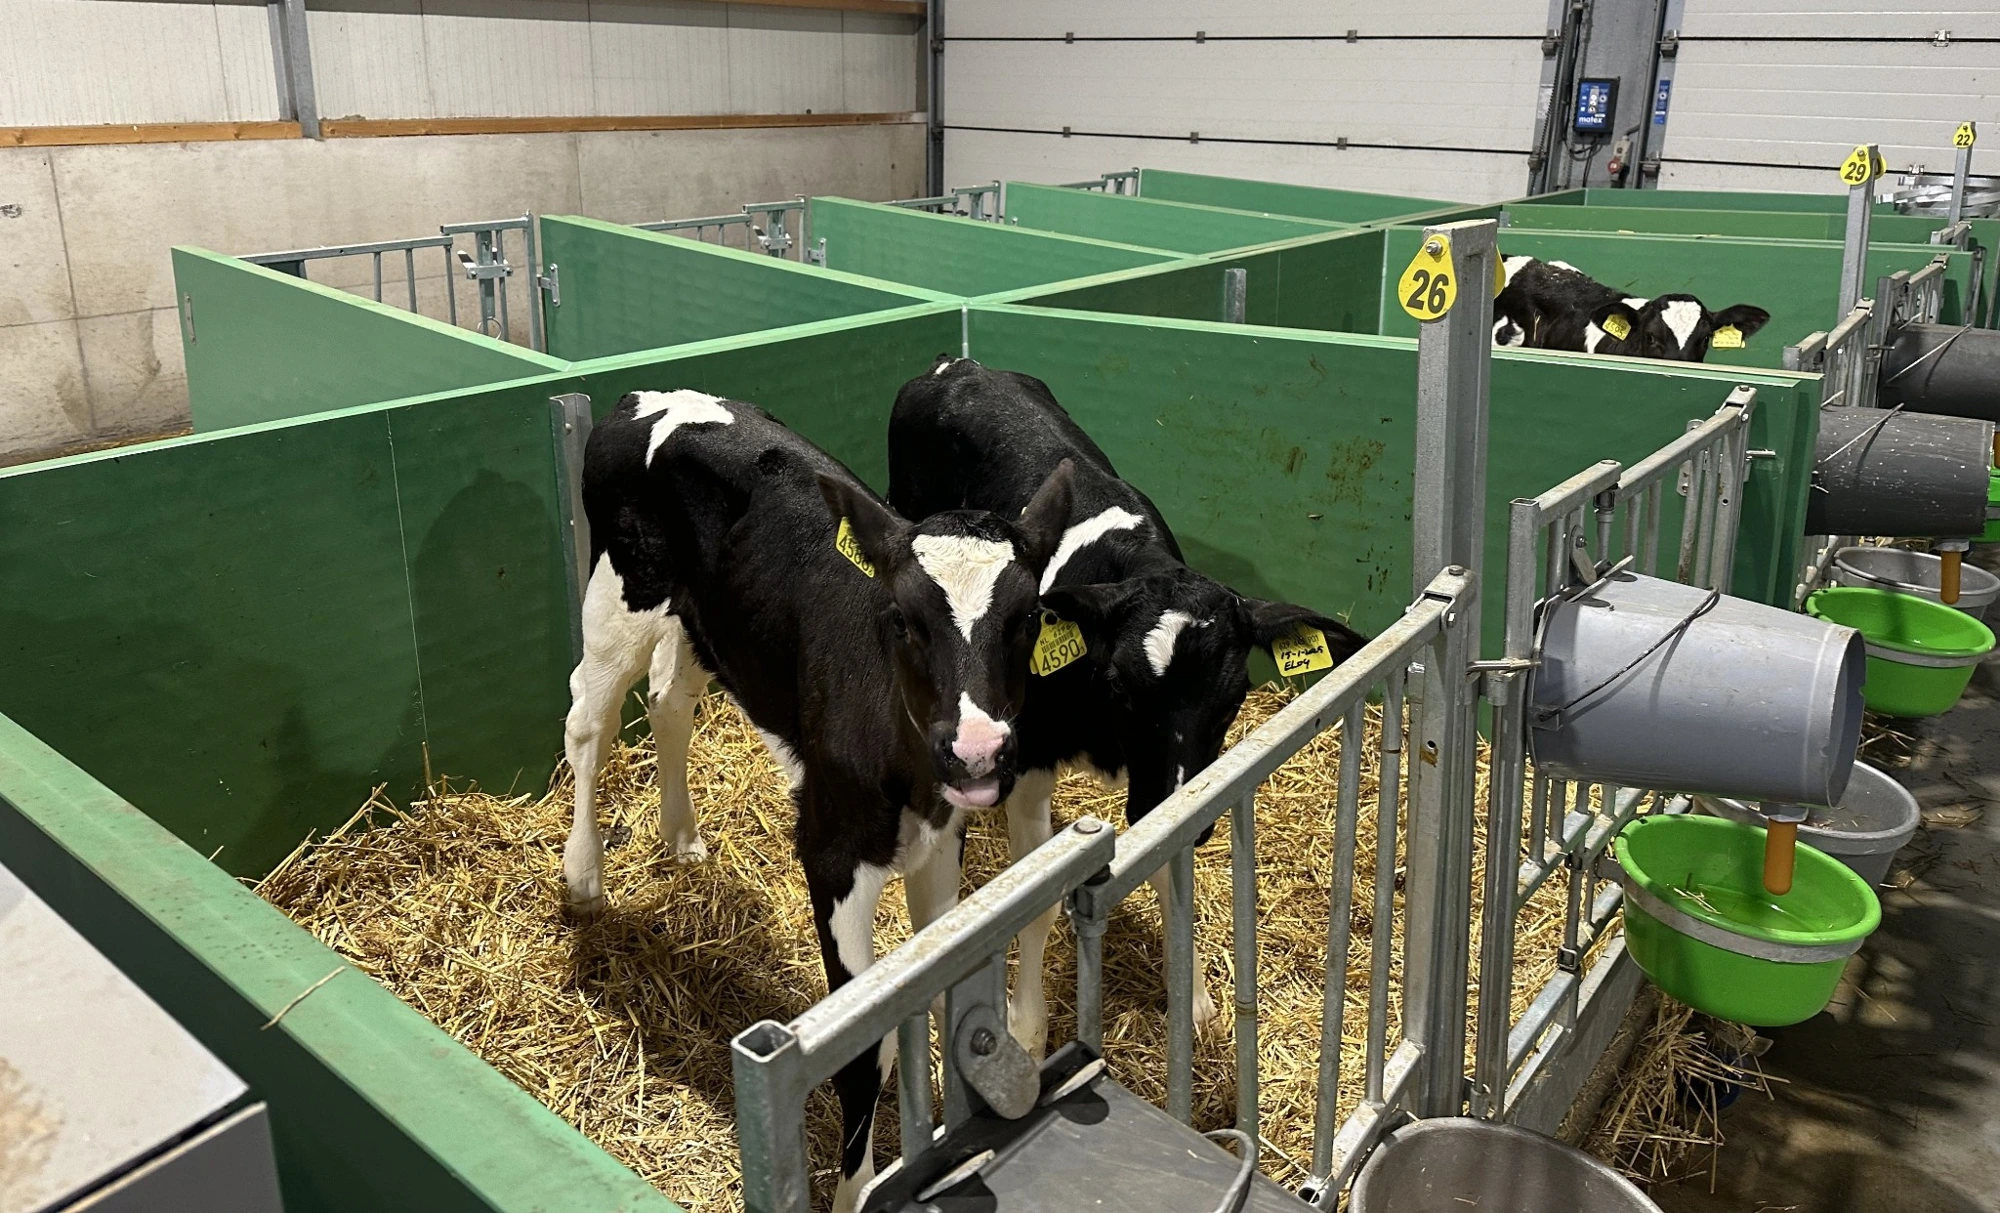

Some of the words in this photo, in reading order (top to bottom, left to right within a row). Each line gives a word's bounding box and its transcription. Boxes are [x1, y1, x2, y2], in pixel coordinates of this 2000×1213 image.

[1956, 134, 1970, 146] 22
[1844, 161, 1867, 182] 29
[1406, 269, 1449, 314] 26
[1040, 637, 1049, 646] NL
[1042, 638, 1081, 672] 4590
